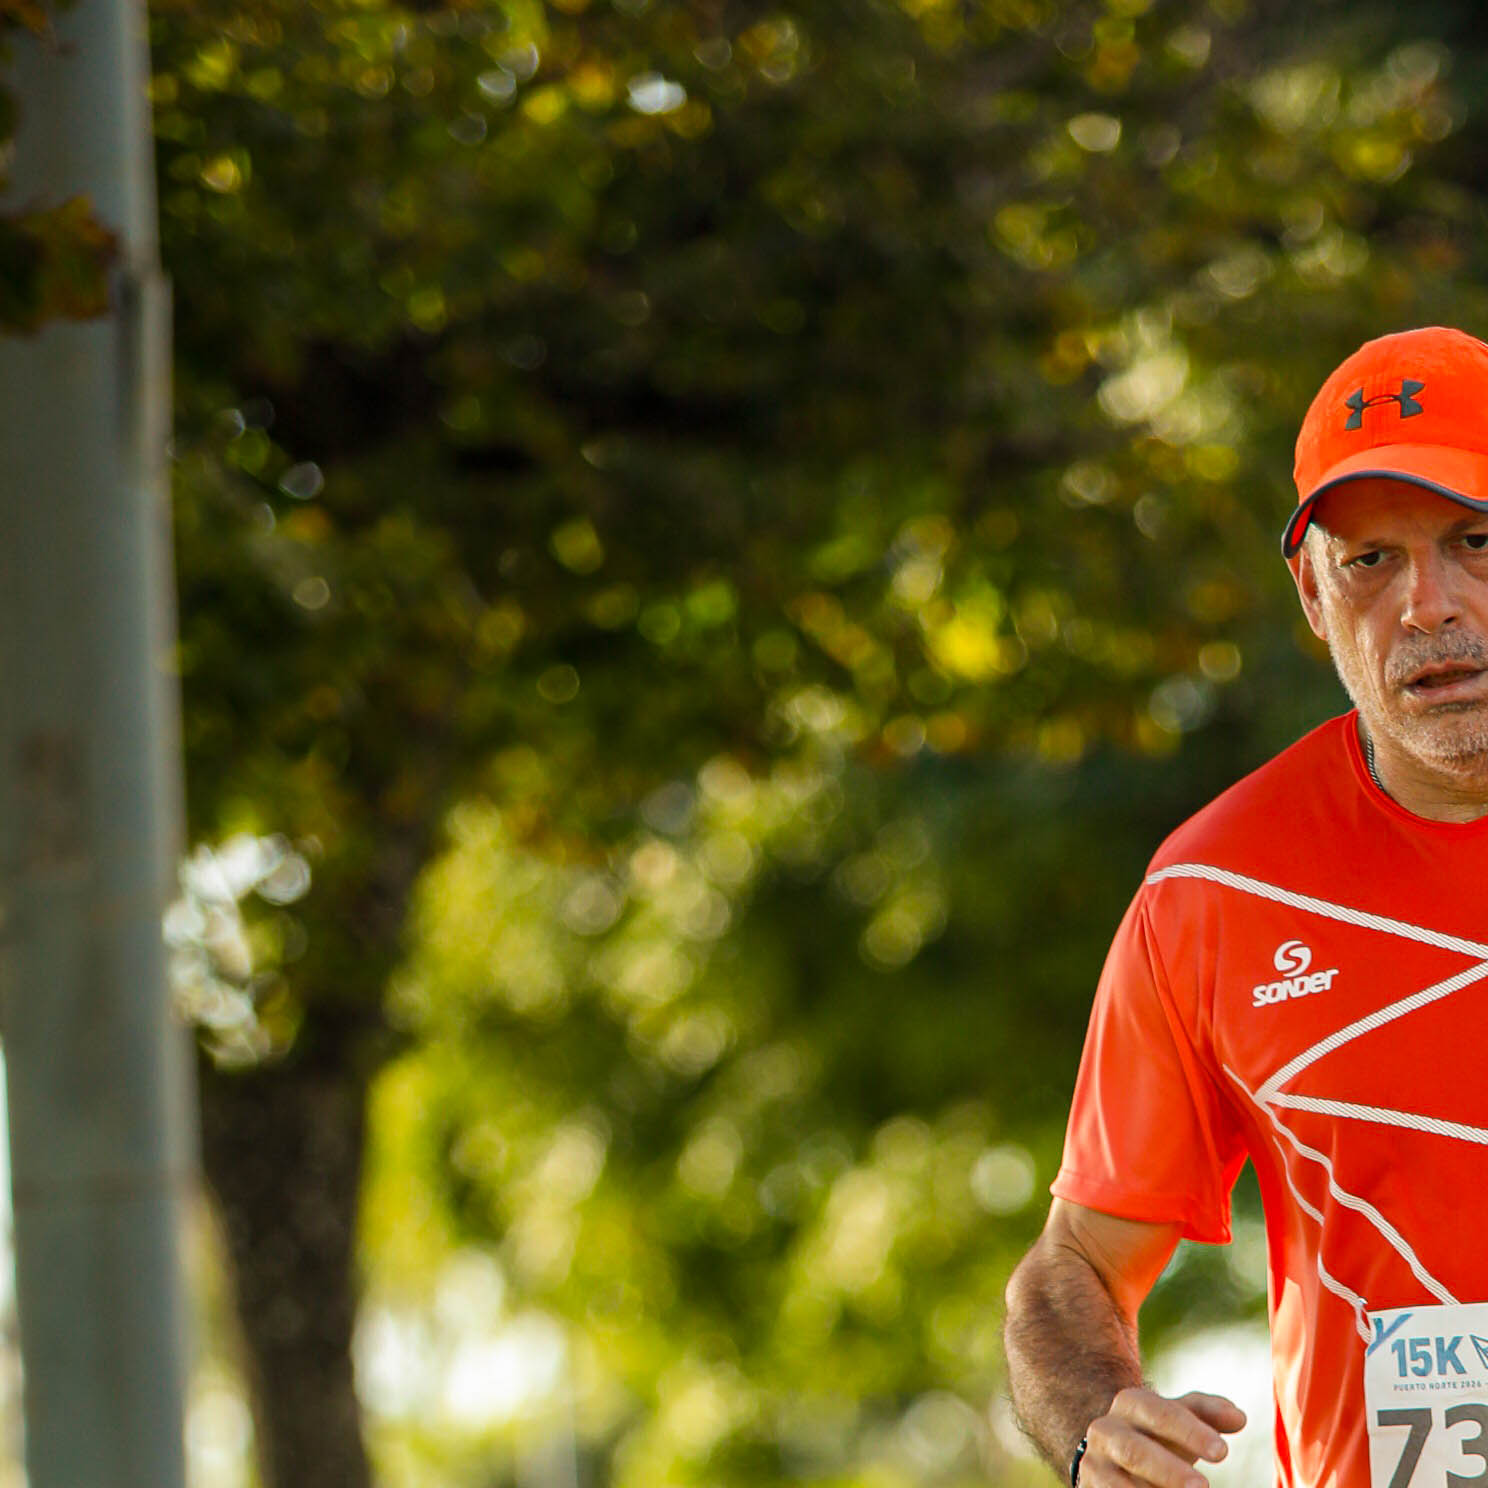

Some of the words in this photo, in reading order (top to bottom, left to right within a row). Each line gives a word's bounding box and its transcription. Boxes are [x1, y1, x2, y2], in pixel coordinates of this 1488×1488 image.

[1391, 1335, 1467, 1377] 15K
[1393, 1382, 1426, 1392] PUERTO
[1429, 1381, 1457, 1390] NORTE
